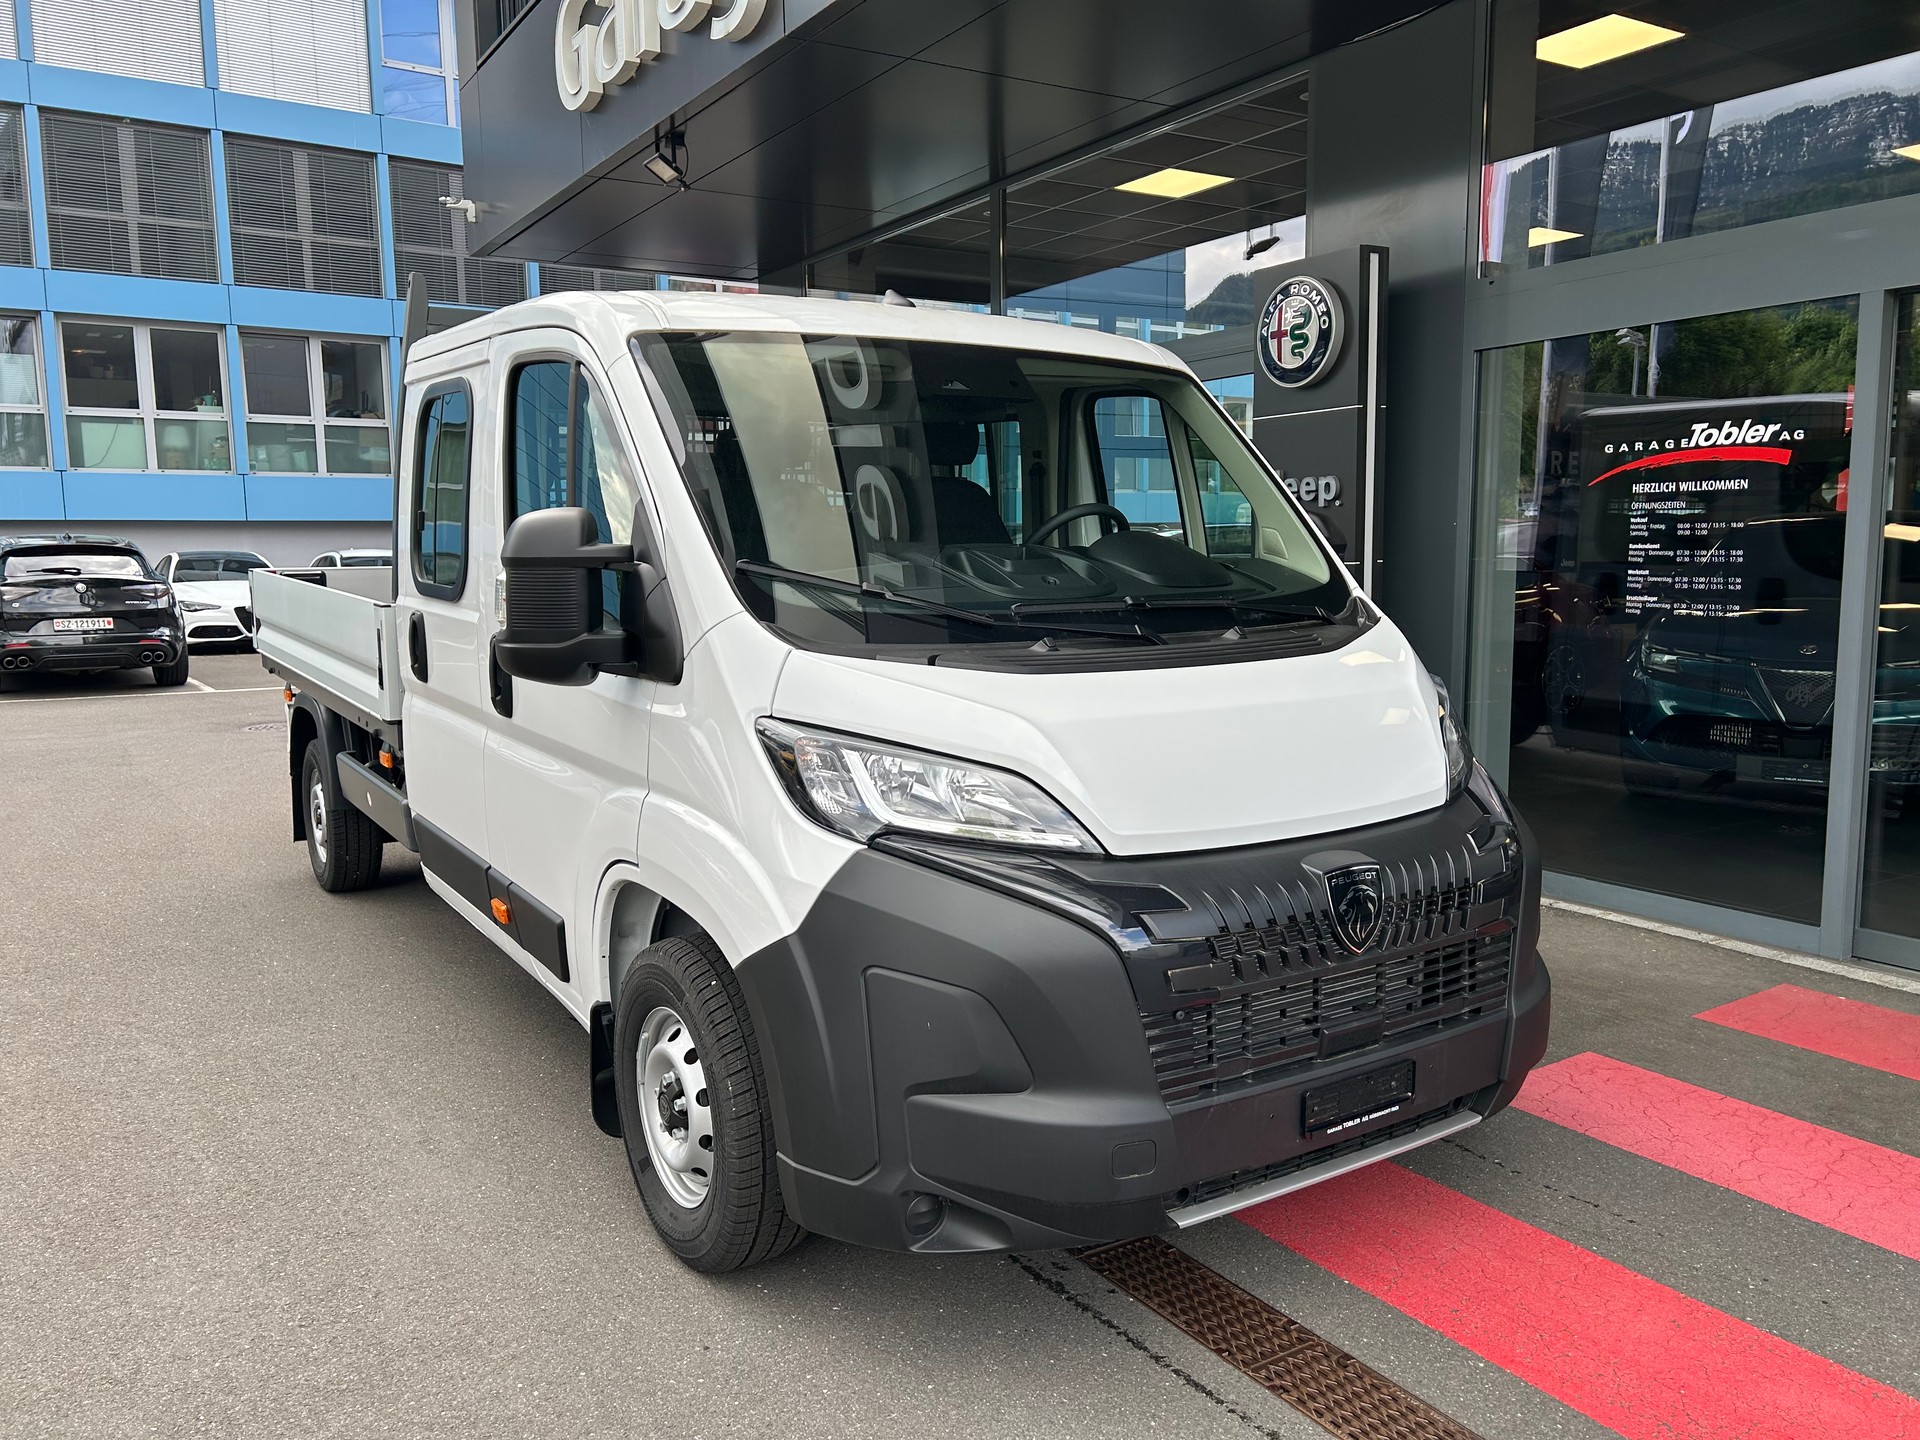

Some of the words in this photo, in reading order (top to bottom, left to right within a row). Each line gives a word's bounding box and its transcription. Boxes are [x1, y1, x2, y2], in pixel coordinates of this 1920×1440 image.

[1261, 293, 1284, 337] ALFA
[1290, 284, 1329, 329] ROMEO
[1604, 438, 1689, 454] GARAGE
[1688, 418, 1782, 448] Tobler
[1778, 429, 1806, 442] AG
[1276, 468, 1340, 508] eep
[1632, 481, 1676, 494] HERZLICH
[1679, 478, 1749, 492] WILLKOMMEN
[1631, 500, 1686, 510] ÖFFNUNGSZEITEN
[1331, 872, 1377, 886] PEUGEOT
[1343, 1118, 1360, 1128] TOBLER
